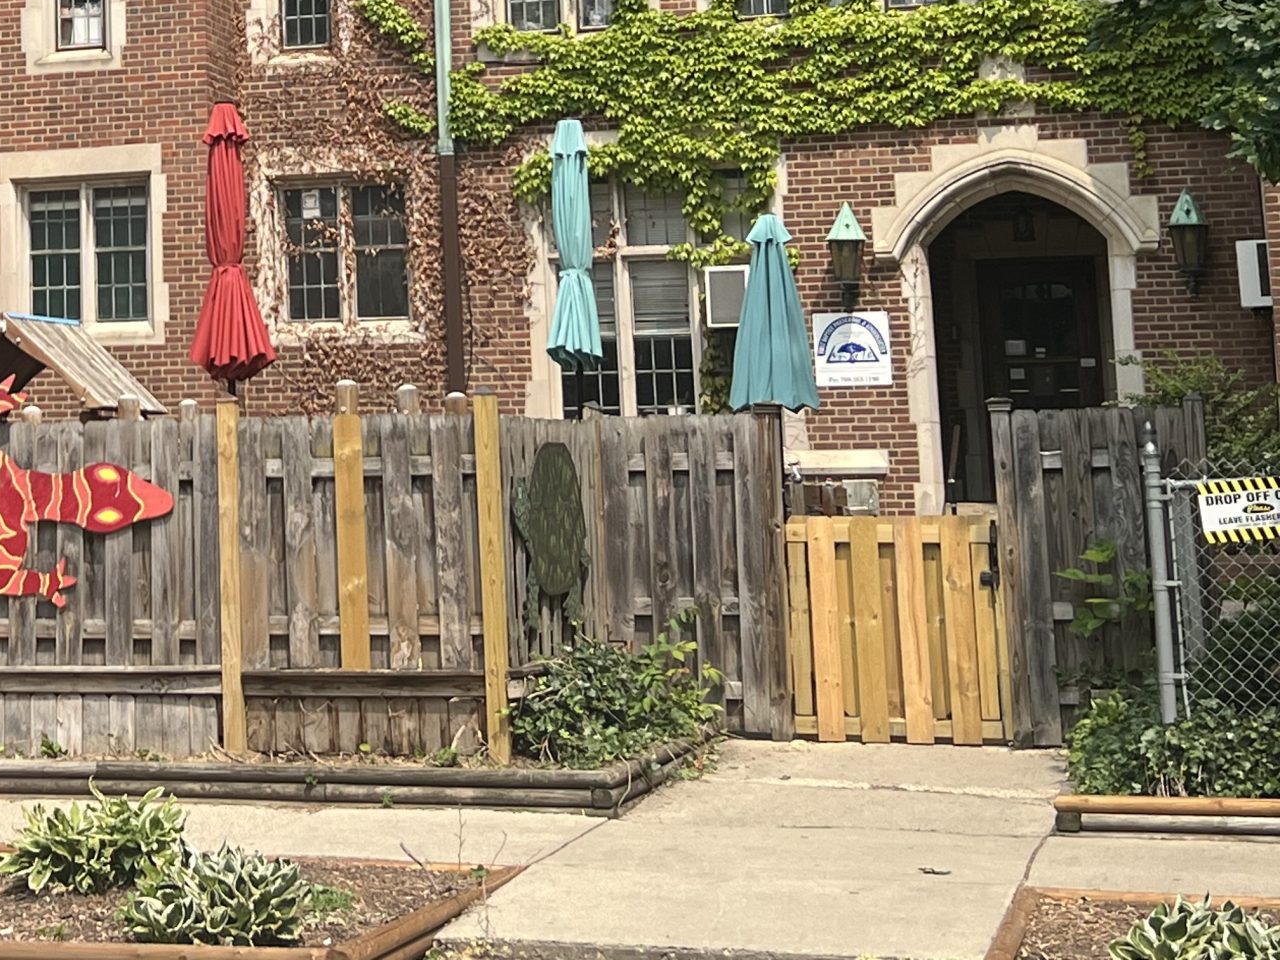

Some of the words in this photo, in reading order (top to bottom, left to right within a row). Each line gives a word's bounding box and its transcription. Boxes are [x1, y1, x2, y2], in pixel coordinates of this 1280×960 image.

[1205, 493, 1241, 506] DROP
[1246, 490, 1270, 502] OFF
[1218, 515, 1243, 525] LEAVE
